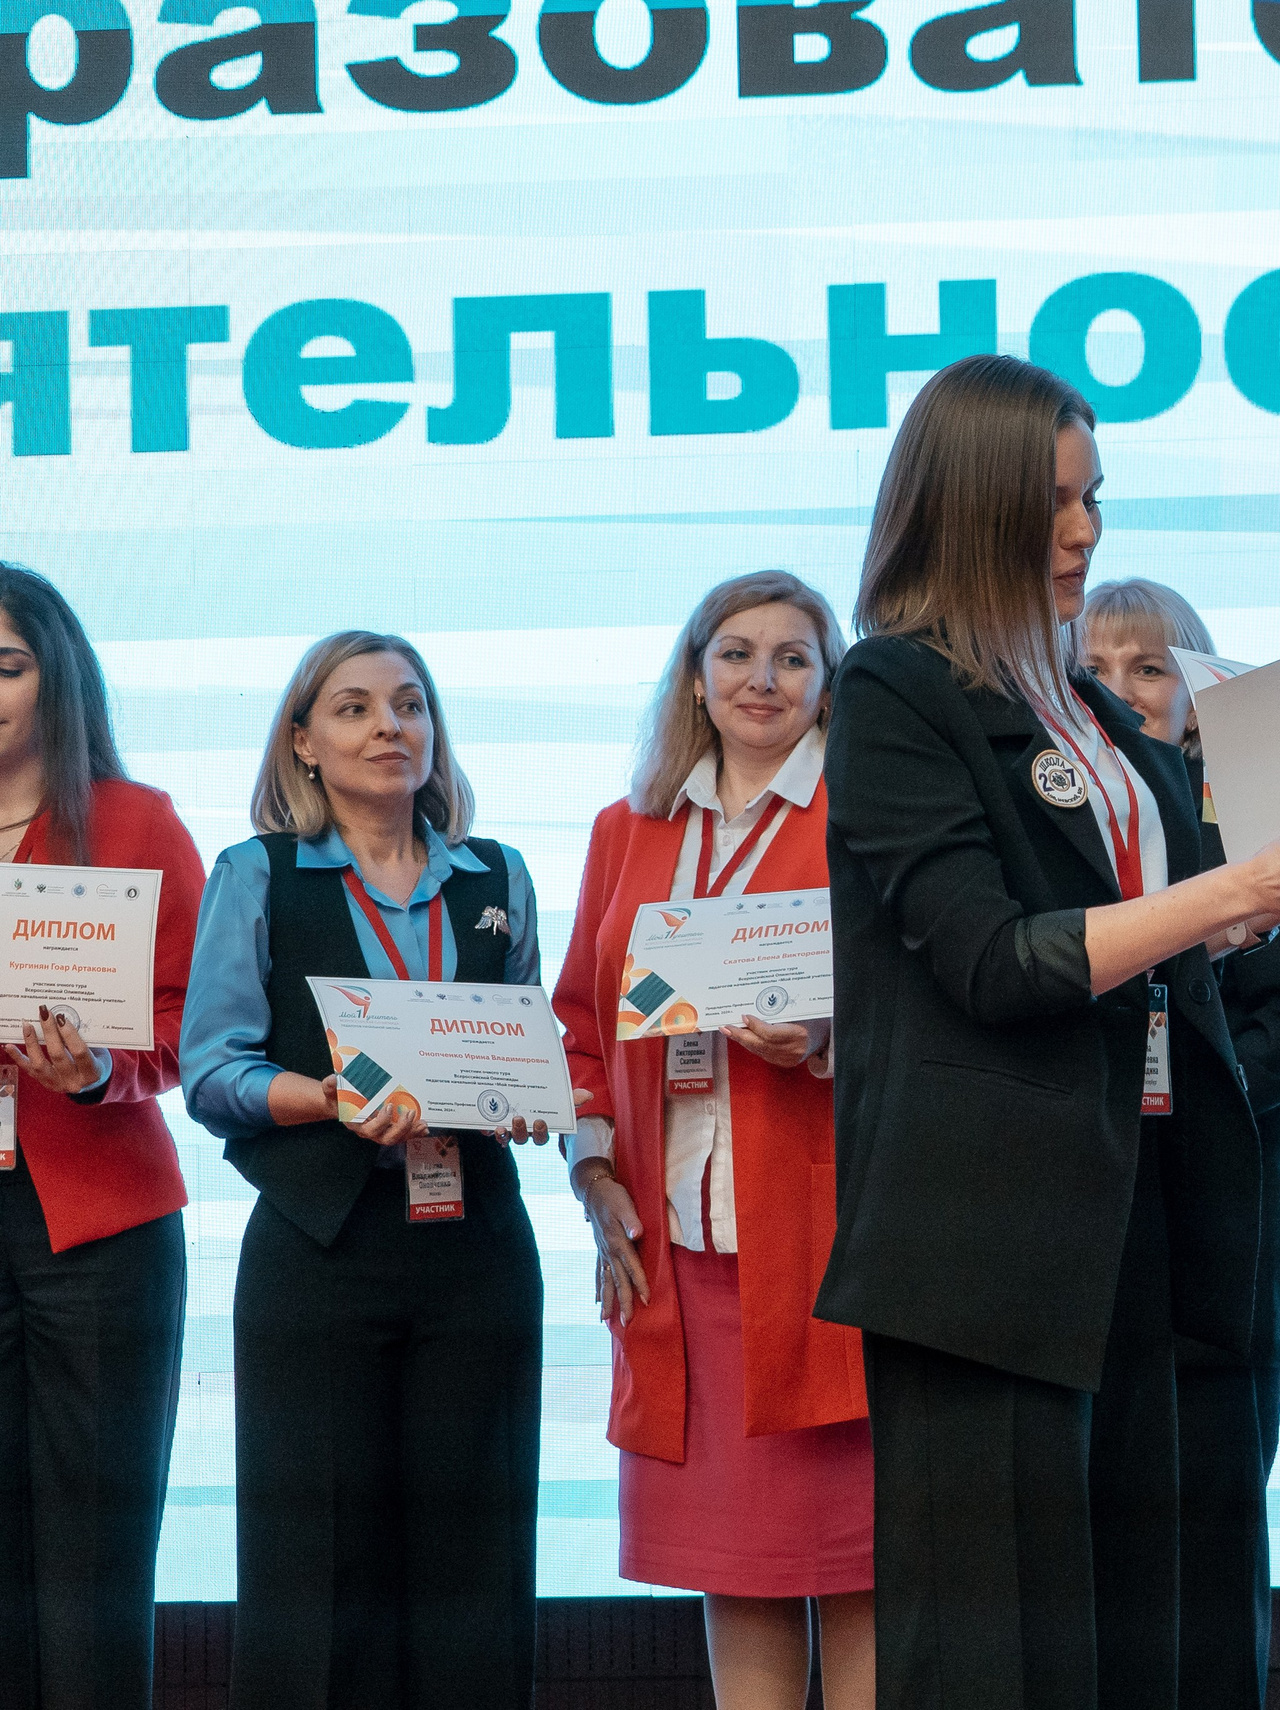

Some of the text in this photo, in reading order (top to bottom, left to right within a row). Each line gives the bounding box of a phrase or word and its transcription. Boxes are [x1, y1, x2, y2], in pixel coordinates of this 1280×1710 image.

[1039, 756, 1066, 773] ШКОЛА
[12, 919, 115, 941] ДИПЛОМ
[731, 920, 829, 944] ДИПЛОМ
[723, 949, 830, 965] Скатова Елена Викторовна
[9, 961, 117, 973] Кургинян Гоар Артаковна
[356, 1009, 362, 1019] 1
[430, 1018, 525, 1037] ДИПЛОМ
[418, 1050, 550, 1064] Онопченко Ирина Владимировна
[676, 1049, 706, 1057] Викторовна
[674, 1081, 709, 1090] УЧАСТНИК
[416, 1204, 455, 1214] УЧАСТНИК
